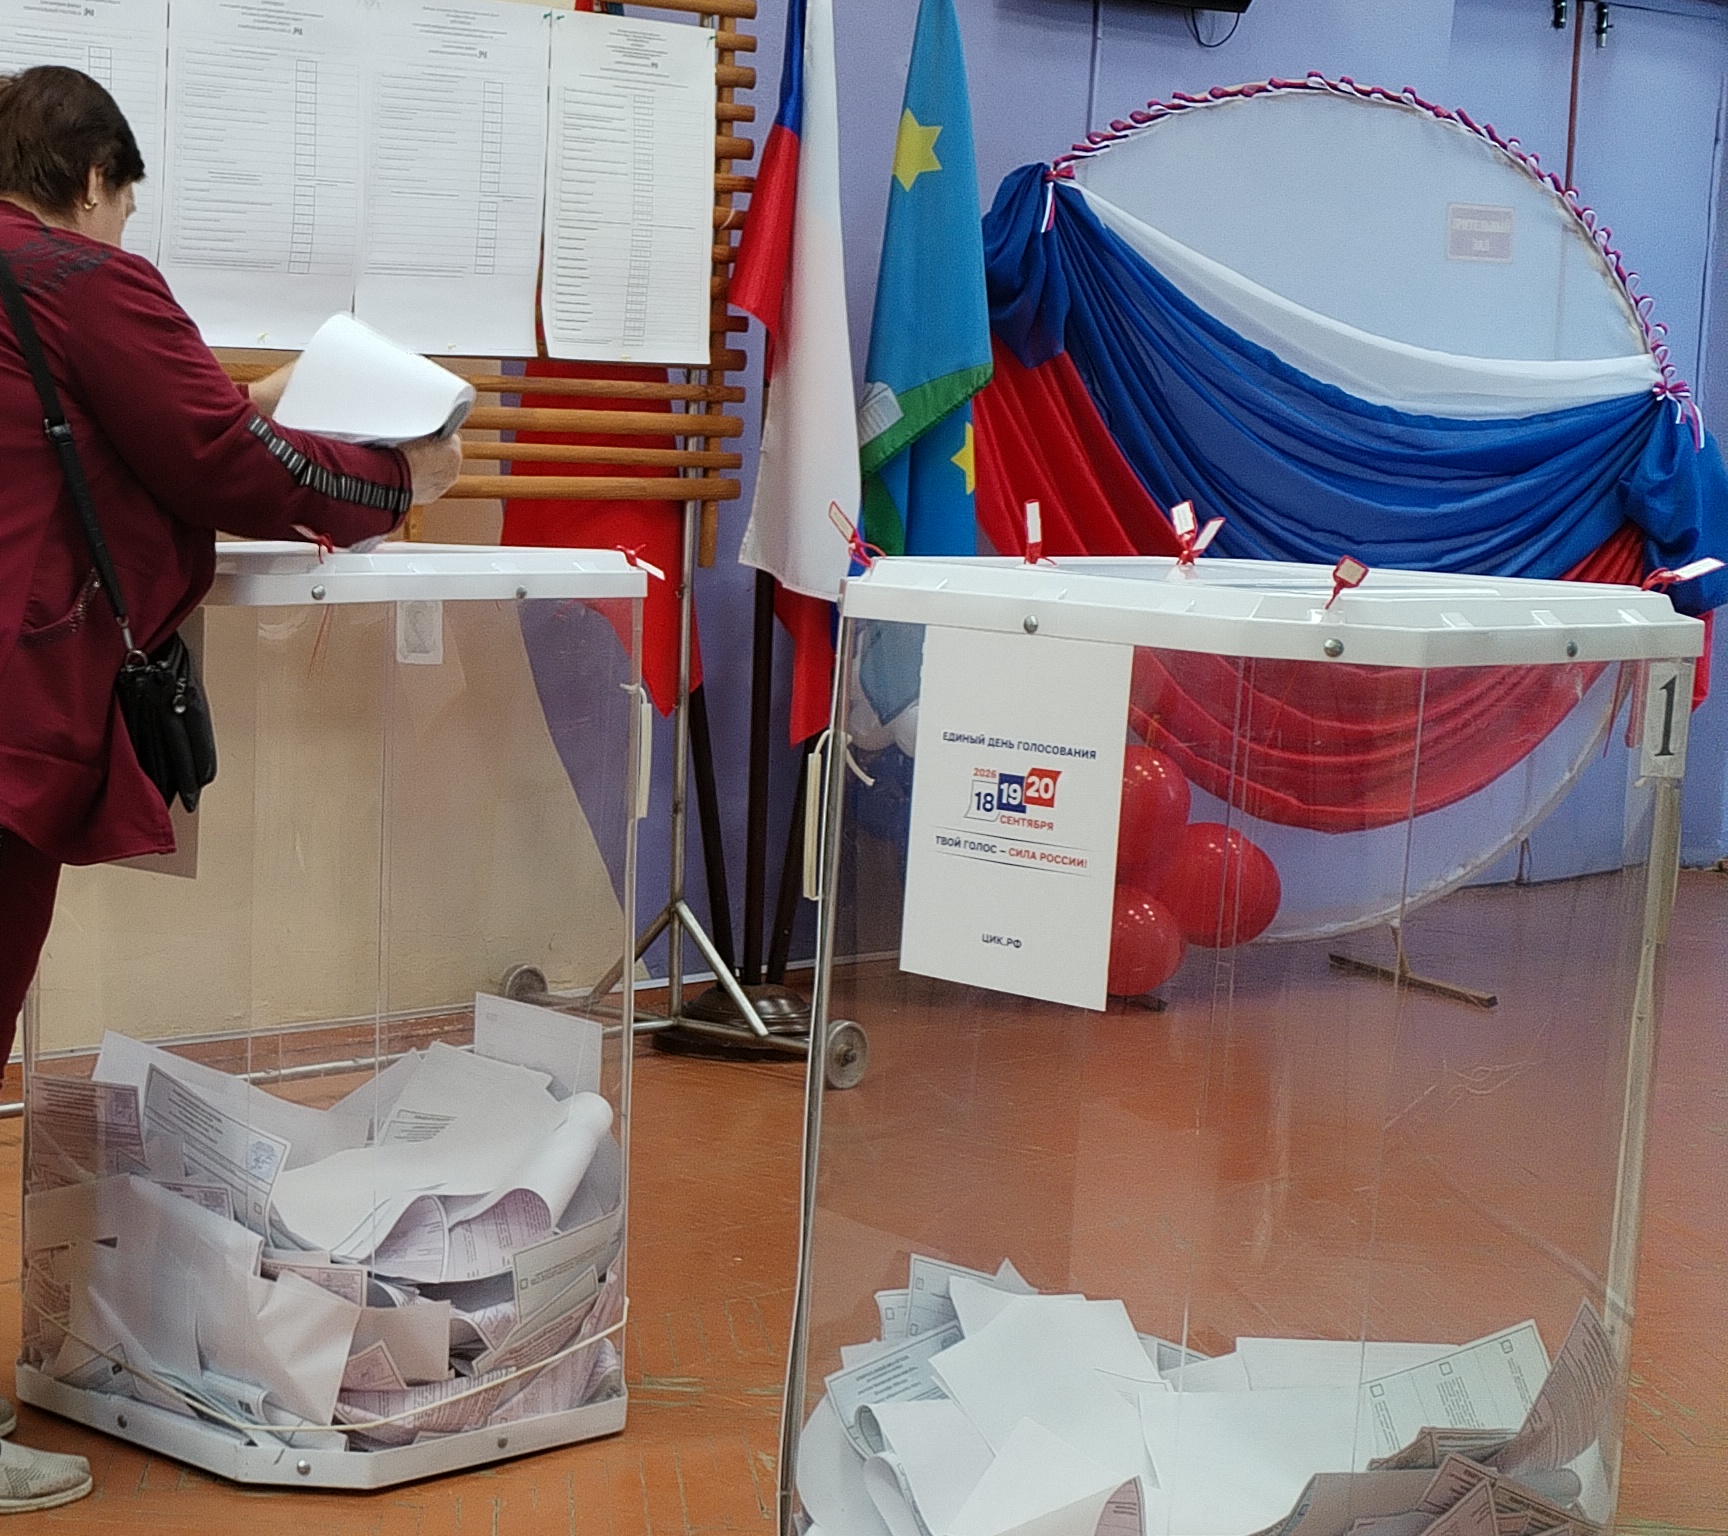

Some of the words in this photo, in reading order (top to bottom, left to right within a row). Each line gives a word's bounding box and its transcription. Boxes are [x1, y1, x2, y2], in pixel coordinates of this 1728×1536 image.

[1654, 674, 1678, 757] 1
[942, 731, 986, 745] ЕДИНЫЙ
[987, 737, 1015, 749] ДЕНЬ
[1017, 741, 1097, 760] ГОЛОСОВАНИЯ
[973, 767, 997, 779] 2026
[974, 791, 995, 813] 18
[1000, 782, 1022, 805] 19
[1025, 775, 1055, 800] 20
[1000, 815, 1054, 831] СЕНТЯБРЯ
[935, 835, 962, 848] ТВОЙ
[963, 840, 997, 854] ГОЛОС
[1008, 847, 1037, 861] СИЛА
[1039, 852, 1088, 868] РОССИИ!
[981, 933, 1023, 949] ЦИК.РФ
